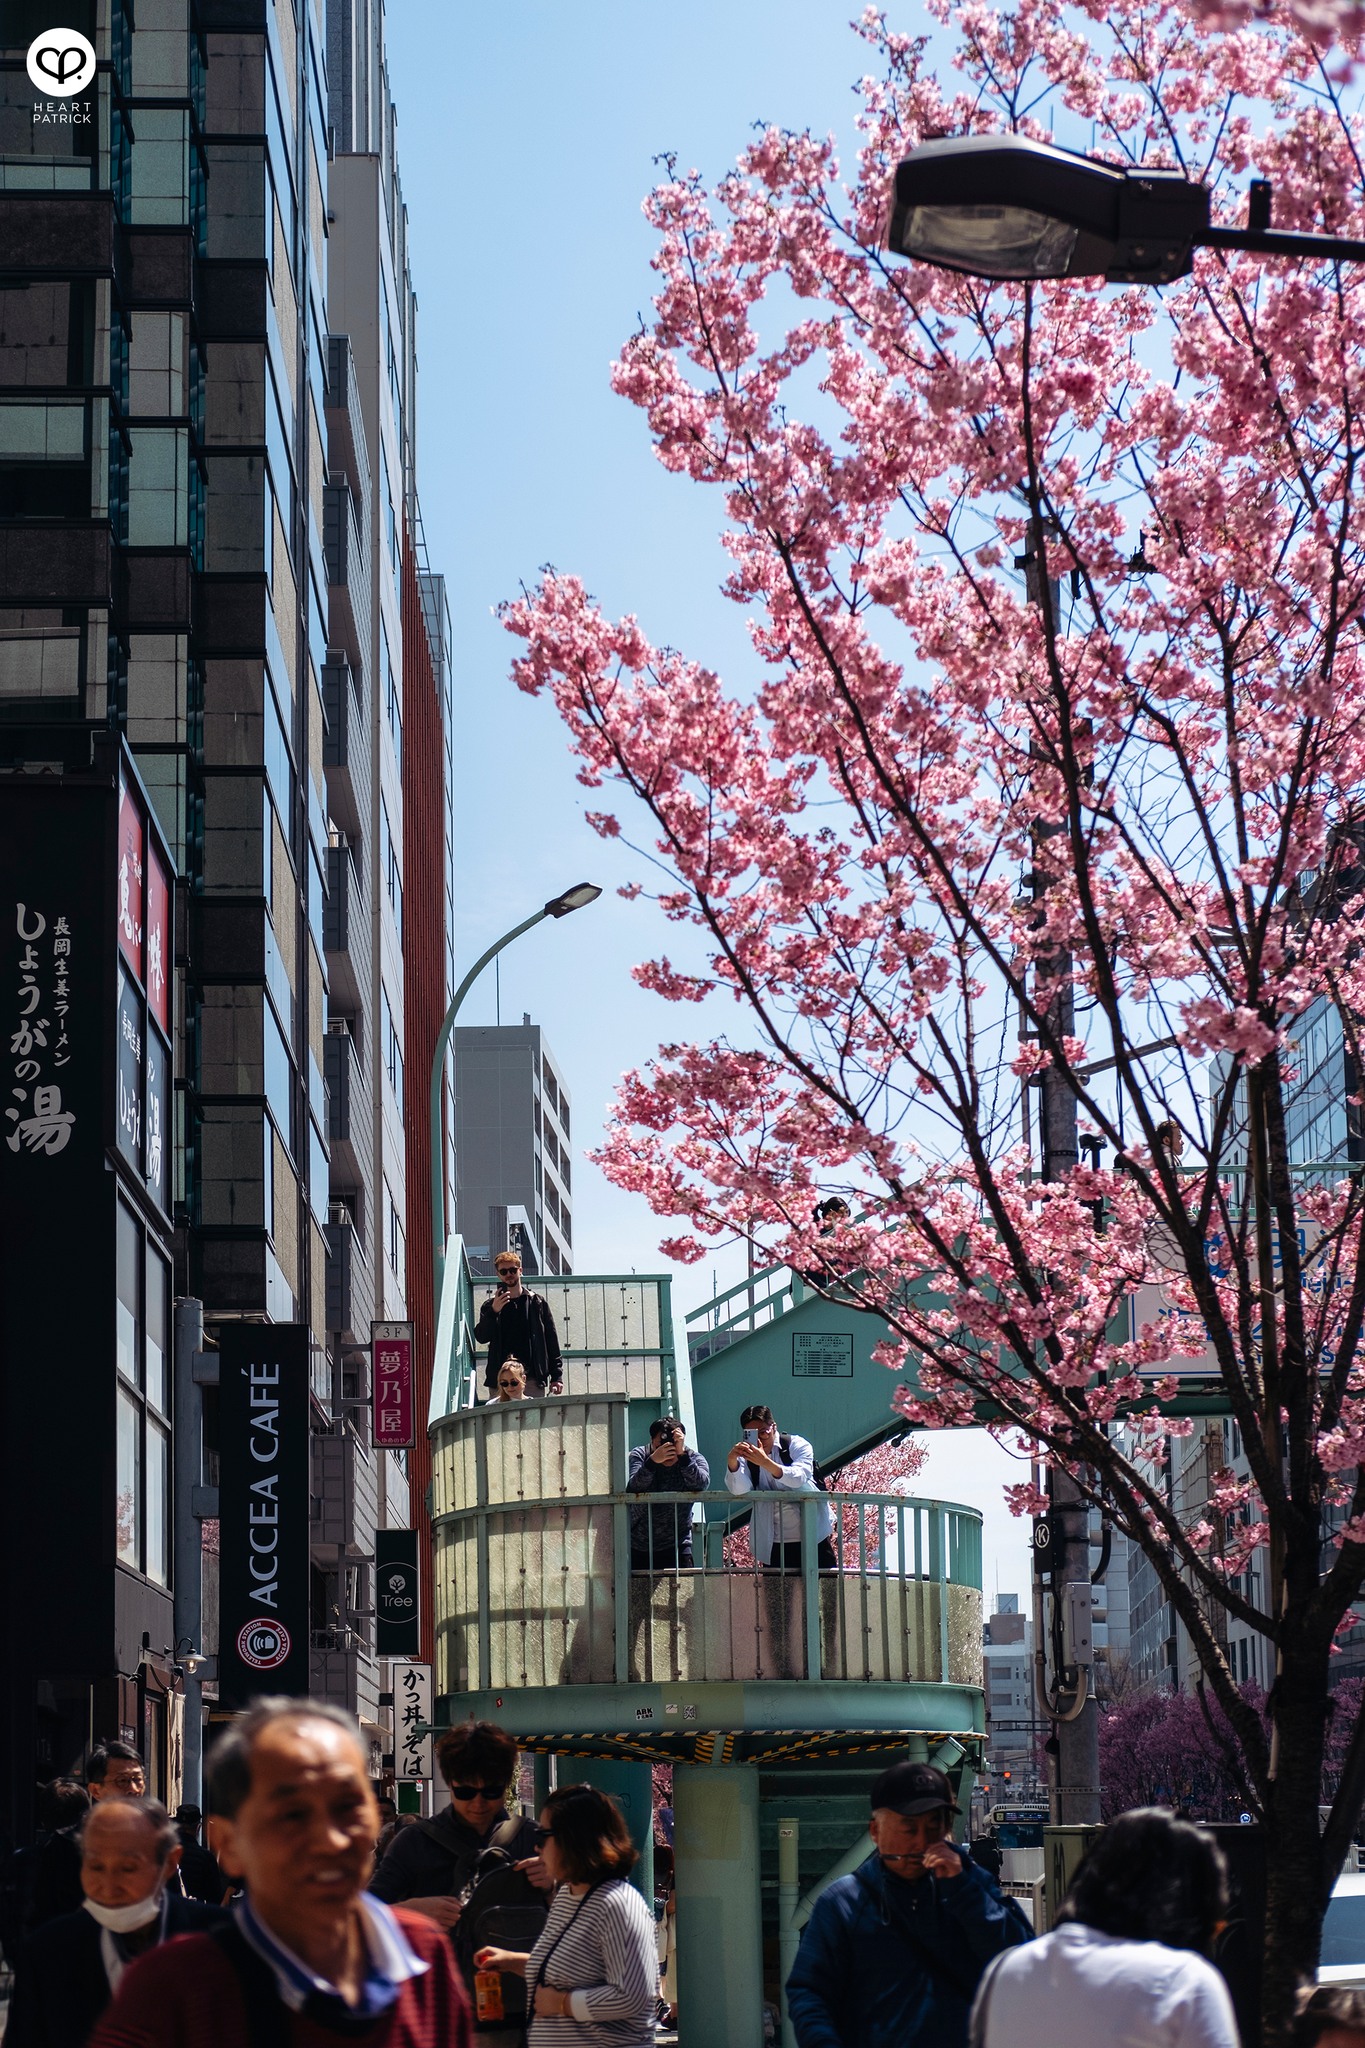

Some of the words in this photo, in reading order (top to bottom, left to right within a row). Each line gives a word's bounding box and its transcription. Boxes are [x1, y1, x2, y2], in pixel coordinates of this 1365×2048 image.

[5, 902, 76, 1156] しょうがの湯
[53, 916, 71, 1067] 長岡生姜ラーメン
[241, 1363, 279, 1463] CAFÉ
[380, 1350, 402, 1432] 夢乃屋
[249, 1474, 279, 1609] ACCEA
[242, 1622, 262, 1640] STATION
[382, 1594, 413, 1607] Tree
[241, 1640, 262, 1665] TELEWORK
[275, 1643, 287, 1661] ACCEA
